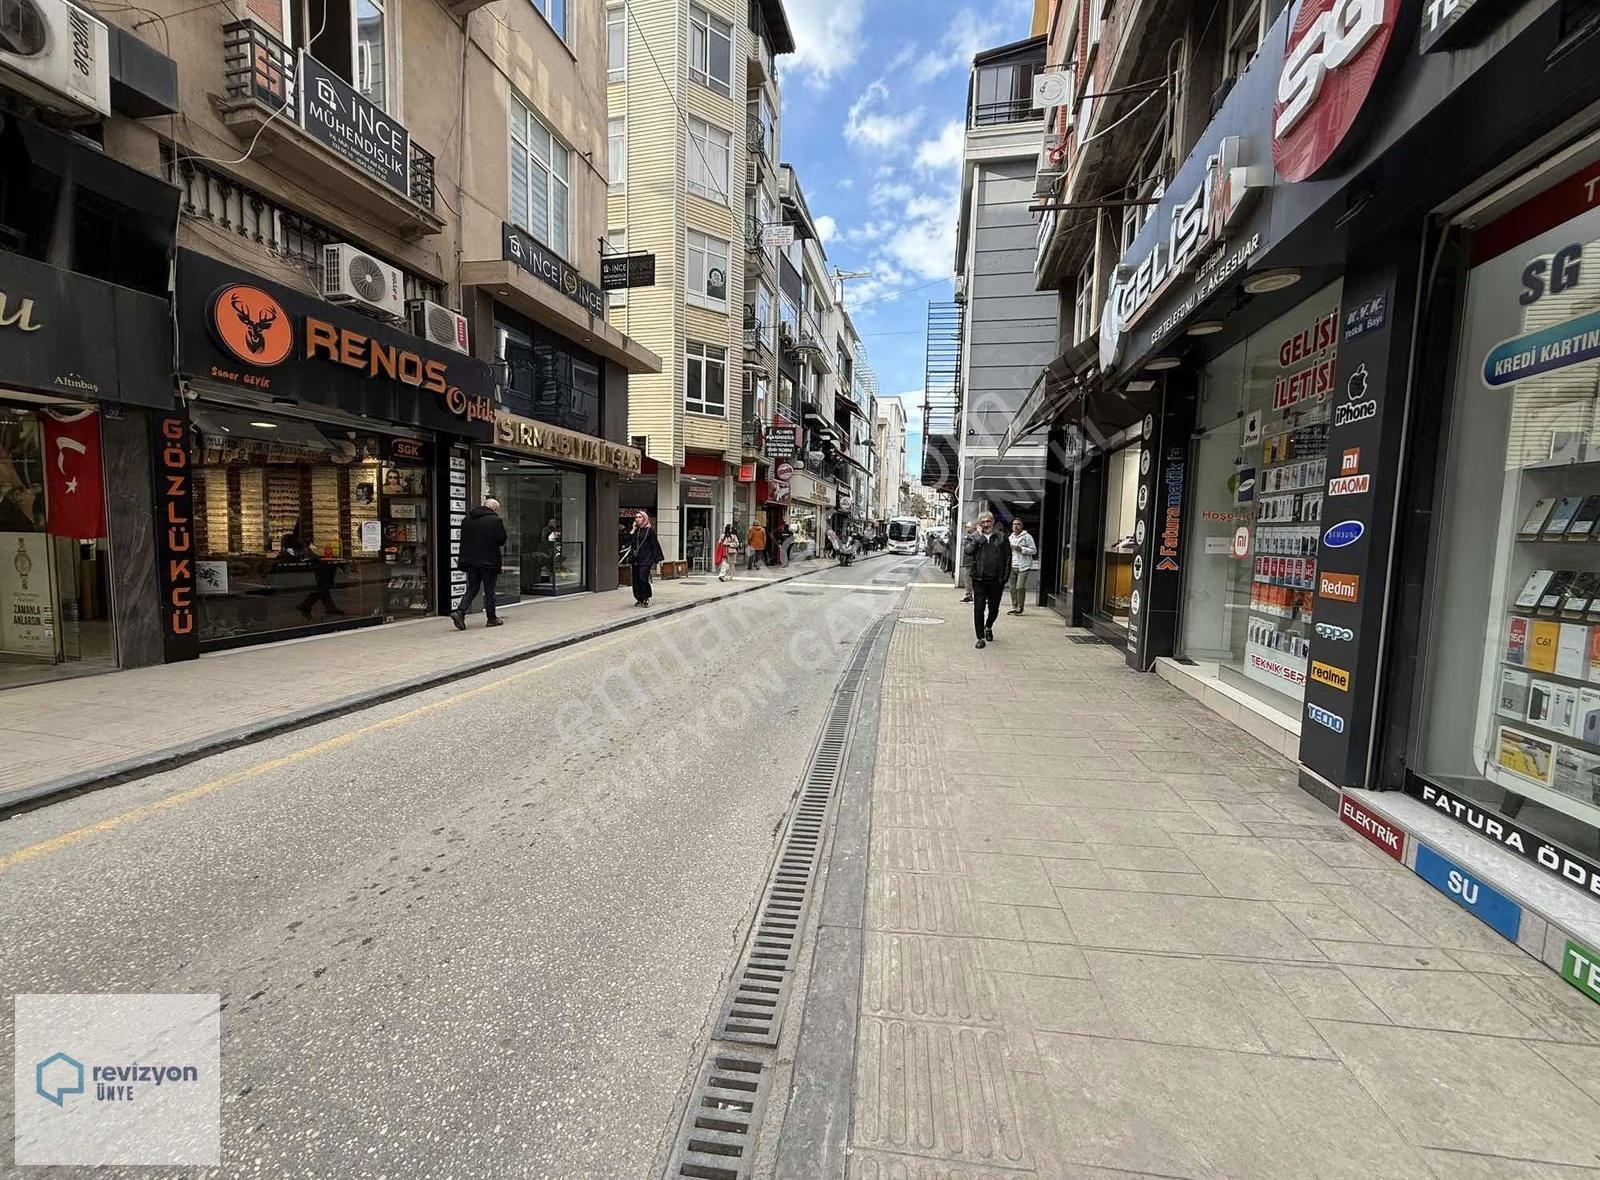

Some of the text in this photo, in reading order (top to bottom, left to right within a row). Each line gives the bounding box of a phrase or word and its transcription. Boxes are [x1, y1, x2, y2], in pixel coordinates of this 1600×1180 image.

[69, 7, 90, 76] arçelik
[309, 101, 403, 176] MÜHENDİSLİK
[351, 97, 402, 154] İNCE
[529, 246, 559, 284] İNCE
[1519, 241, 1583, 306] SG
[580, 281, 602, 312] İNCE
[1151, 325, 1164, 345] CEP
[1163, 294, 1196, 335] TELEFONU
[1207, 232, 1260, 293] AKSESUAR
[1347, 296, 1383, 326] K.V.K.
[306, 316, 448, 395] RENOS
[1495, 329, 1600, 377] KREDİ KARTIN
[446, 386, 497, 424] Optik
[1335, 401, 1376, 425] iPhone
[397, 443, 419, 457] SGK
[1330, 476, 1368, 494] XIAOMI
[162, 418, 194, 636] GÖZLÜKCÜ
[1160, 462, 1185, 557] Faturamatik
[1327, 527, 1359, 540] SAMSUNG
[1321, 579, 1356, 598] Redmi
[13, 604, 41, 614] ZAMANLA
[1316, 624, 1352, 640] oppo
[1535, 636, 1552, 647] C61
[1250, 654, 1305, 685] TEKNİK SER
[1312, 665, 1347, 687] realme
[1308, 703, 1344, 734] TECNO
[1343, 801, 1400, 850] ELEKTRİK
[1423, 785, 1525, 854] FATURA
[1447, 870, 1479, 905] SU
